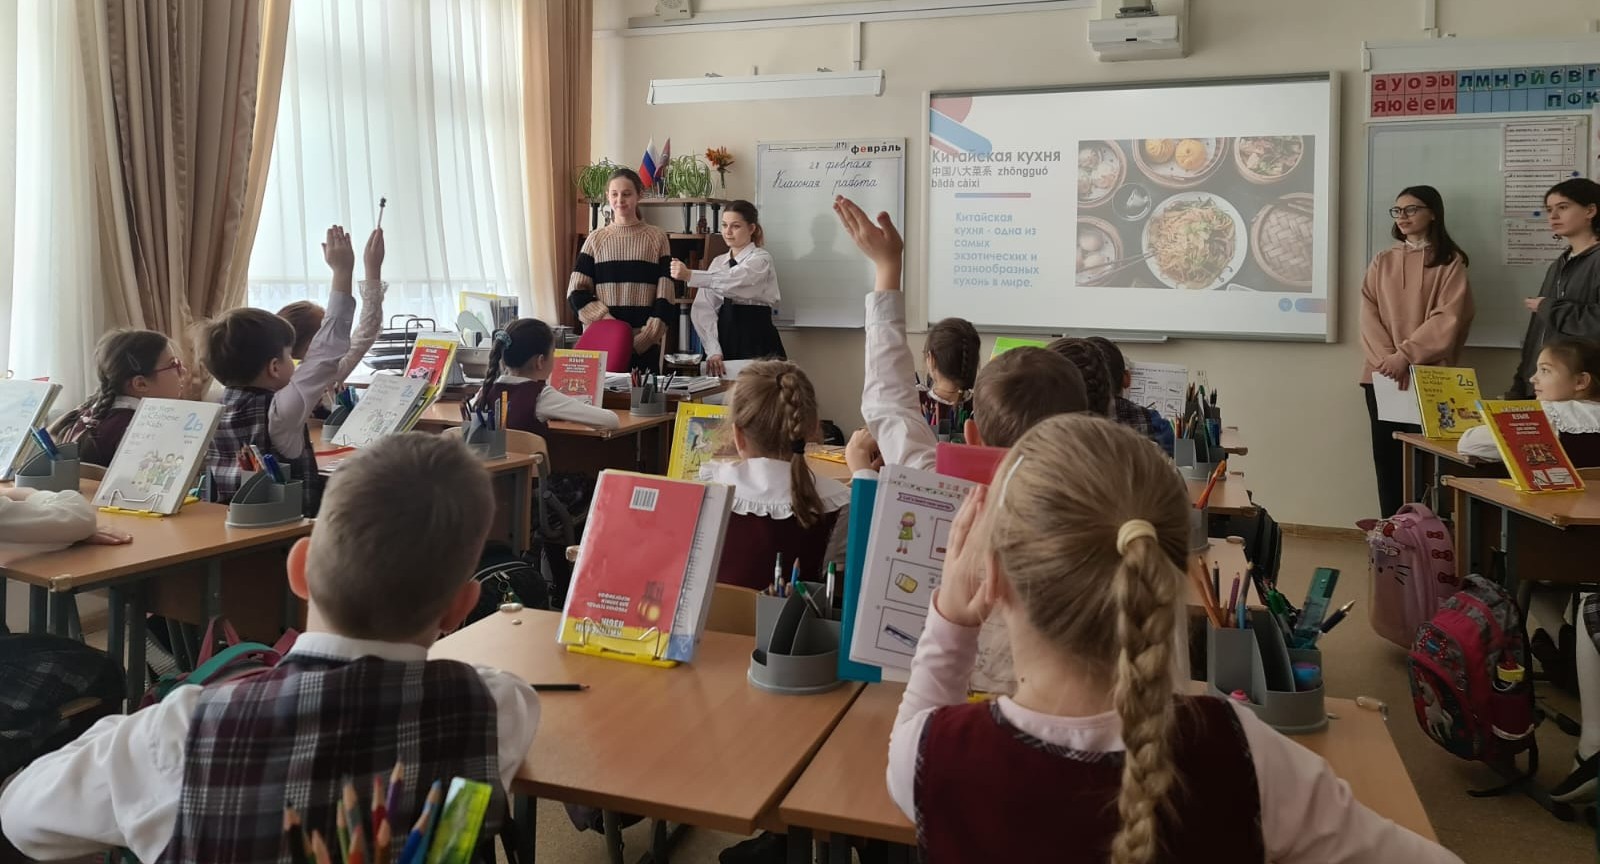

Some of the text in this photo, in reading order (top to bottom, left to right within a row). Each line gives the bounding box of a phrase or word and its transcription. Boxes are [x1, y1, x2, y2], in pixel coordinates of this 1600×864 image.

[932, 150, 1061, 165] Китайская кухня
[932, 166, 993, 177] 中国八大菜系
[956, 212, 1013, 222] Китайская
[954, 227, 984, 236] кухня
[994, 227, 1022, 235] одна
[1024, 227, 1037, 235] из
[954, 239, 990, 248] самых
[953, 252, 1038, 261] экзотических и
[953, 263, 1040, 275] разнообразных
[1000, 279, 1033, 288] мире.
[1456, 373, 1474, 387] 2b
[183, 412, 204, 431] 2b
